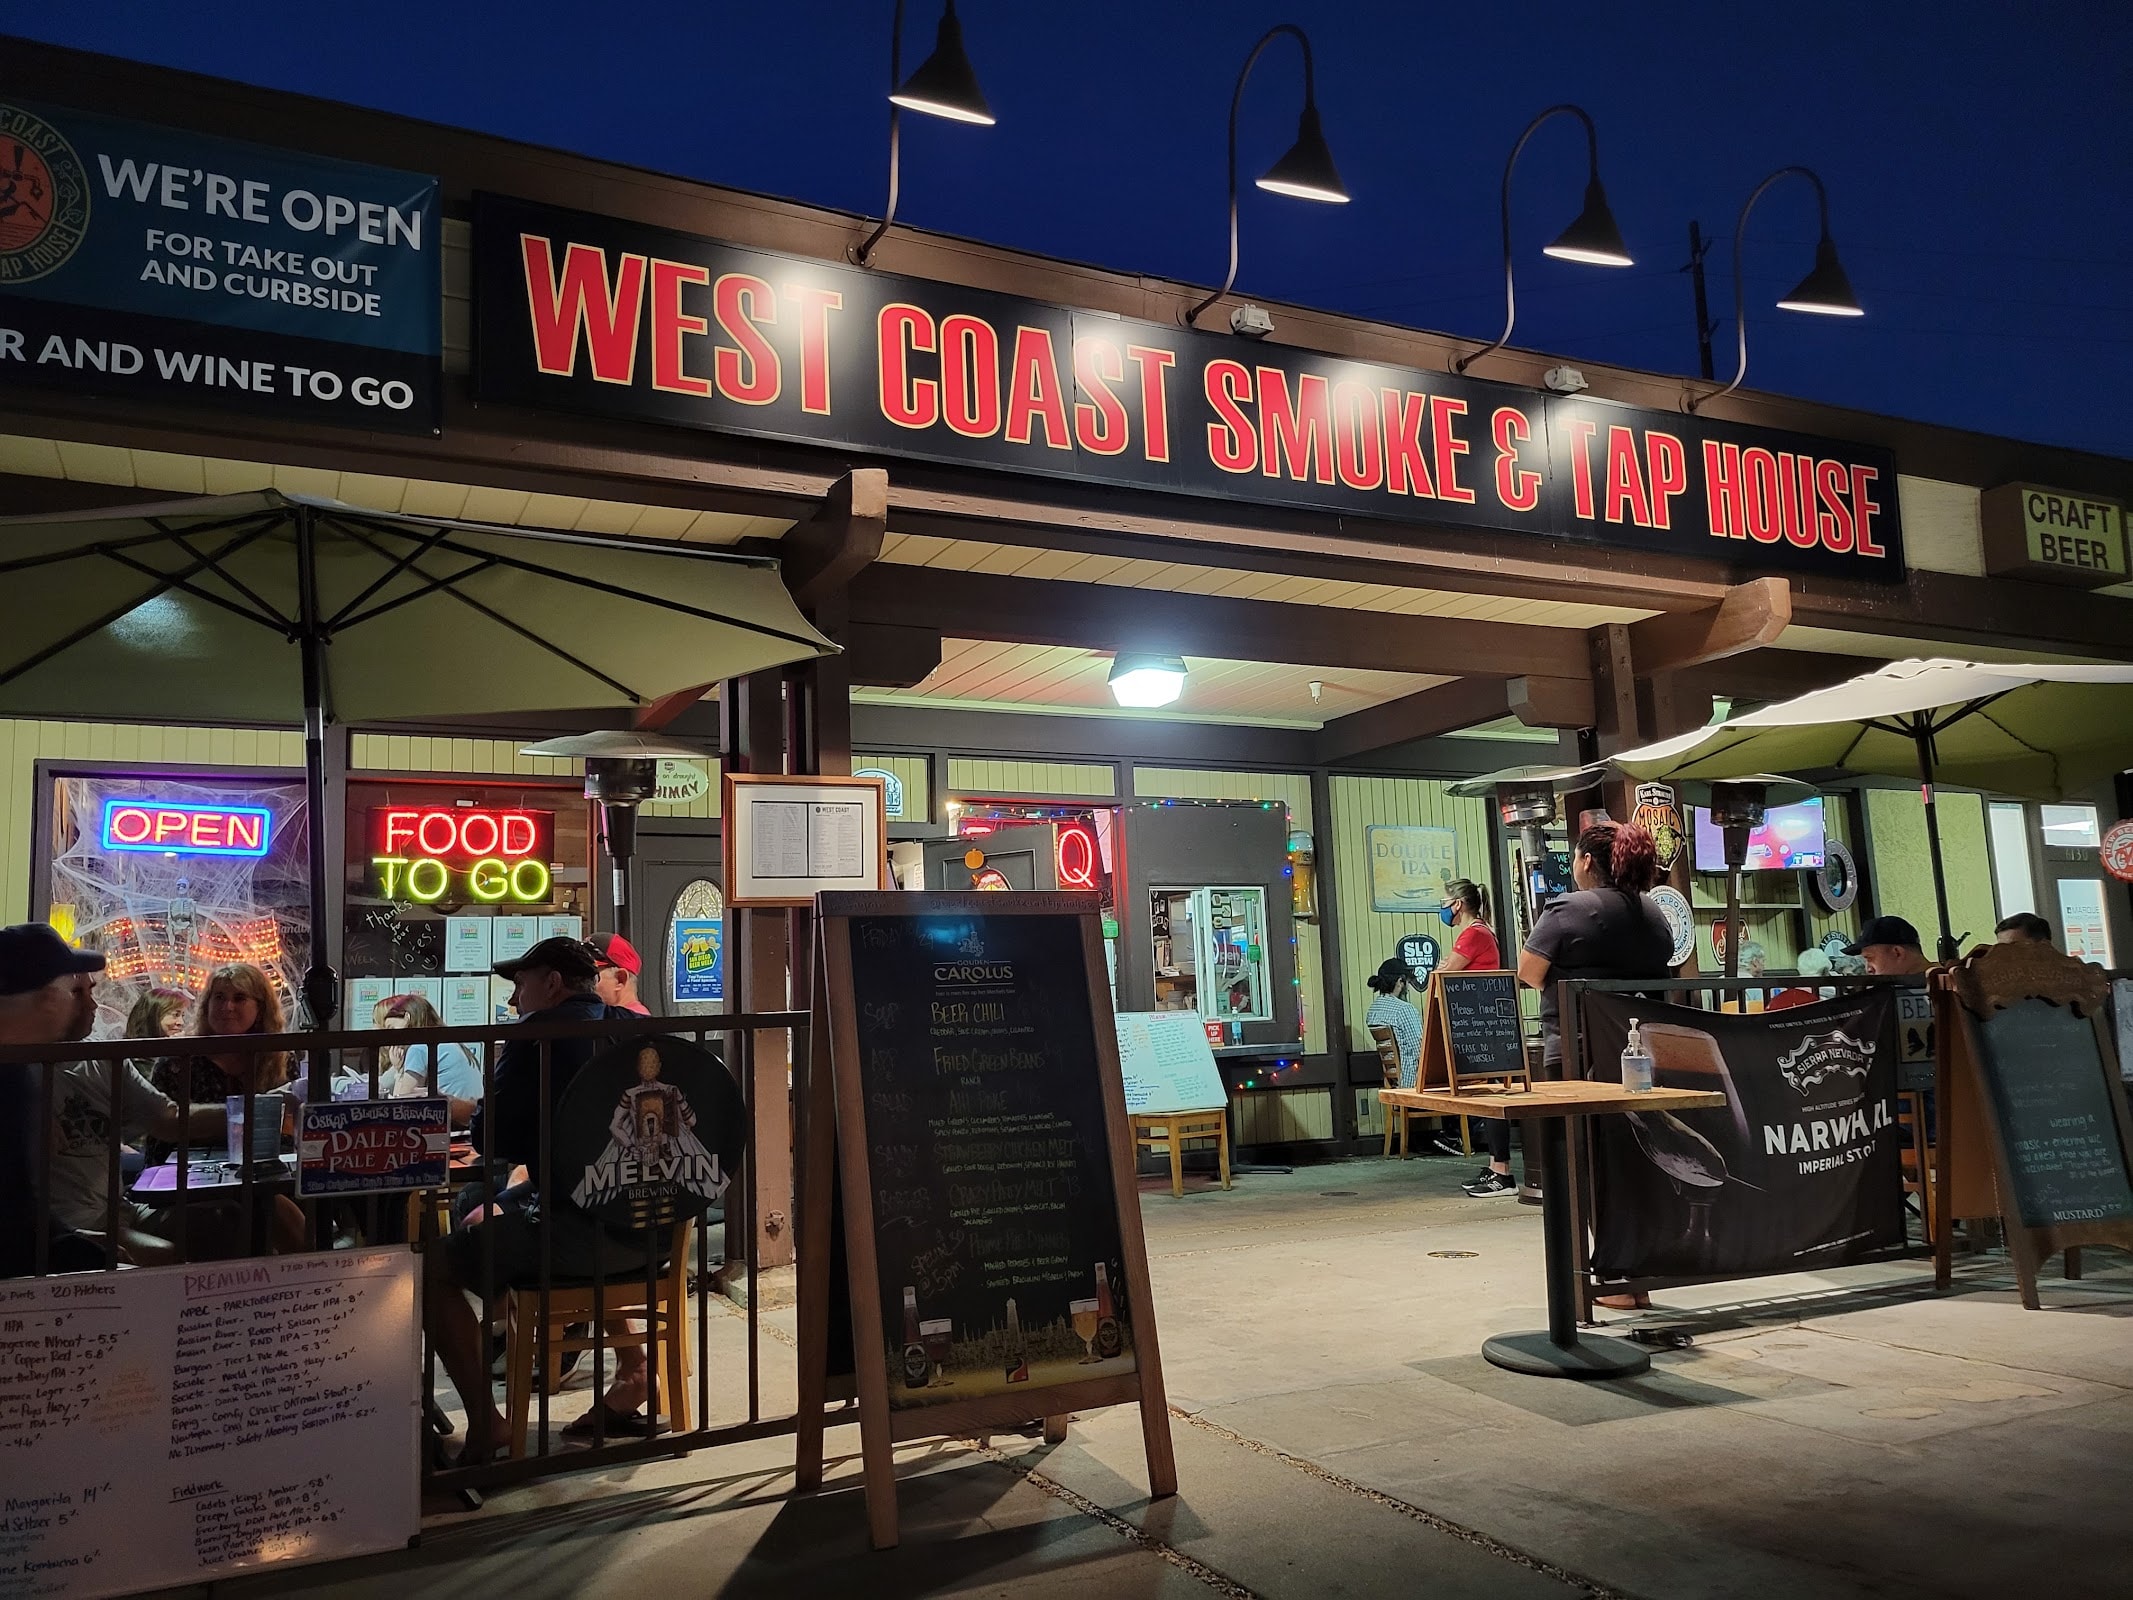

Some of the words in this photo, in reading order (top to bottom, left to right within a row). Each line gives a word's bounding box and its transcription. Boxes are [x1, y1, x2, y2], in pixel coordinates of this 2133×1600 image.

[98, 154, 270, 223] WE'RE
[281, 190, 421, 251] OPEN
[24, 227, 77, 272] HOUSE
[146, 229, 214, 261] FOR
[221, 241, 304, 276] TAKE
[311, 256, 378, 287] OUT
[140, 259, 216, 291] AND
[223, 273, 381, 317] CURBSIDE
[37, 335, 144, 375] AND
[154, 348, 275, 393] WINE
[284, 366, 343, 400] TO
[351, 377, 414, 409] GO
[520, 233, 843, 416] WEST
[878, 303, 1176, 463] COAST
[1204, 359, 1475, 505] SMOKE
[1491, 406, 1542, 512] &
[1557, 417, 1687, 531] TAP
[1702, 439, 1886, 558] HOUSE
[2029, 494, 2110, 533] CRAFT
[2040, 533, 2109, 569] BEER
[655, 780, 699, 799] HIMAY
[1639, 808, 1675, 826] MOSAIC
[110, 807, 264, 850] OPEN
[384, 811, 537, 856] FOOD
[1376, 841, 1452, 860] DOUBLE
[1401, 861, 1431, 875] IPA
[372, 856, 449, 900] TO
[469, 857, 550, 900] GO
[366, 899, 413, 929] thanks
[390, 920, 402, 937] for
[391, 924, 411, 945] your
[1404, 942, 1432, 957] SLO
[1405, 958, 1433, 966] BREW
[934, 965, 1014, 983] CAROLUS
[1462, 980, 1477, 992] Are
[930, 1001, 969, 1024] BEER
[973, 1002, 1005, 1023] CHILI
[1450, 1002, 1475, 1016] Please
[1479, 1002, 1496, 1015] have
[1472, 1017, 1485, 1027] from
[1487, 1019, 1498, 1028] your
[1500, 1018, 1517, 1028] party
[1485, 1028, 1493, 1037] for
[1454, 1043, 1476, 1054] PLEASE
[1506, 1043, 1519, 1051] SEAT
[933, 1046, 969, 1076] FRIED
[1466, 1054, 1495, 1063] YOURSELF
[1796, 1050, 1829, 1075] SIERRA
[1828, 1048, 1865, 1064] NEVADA
[307, 1112, 349, 1130] OSKAR
[351, 1105, 390, 1122] BLUES
[392, 1104, 446, 1124] BREWERY
[1801, 1105, 1815, 1113] HIGH
[1815, 1102, 1838, 1111] ALTITUDE
[2050, 1115, 2087, 1131] wearing
[330, 1126, 422, 1154] DALE'S
[329, 1153, 376, 1174] PALE
[383, 1151, 421, 1170] ALE
[1799, 1154, 1845, 1175] IMPERIAL
[584, 1153, 720, 1196] MELVIN
[628, 1184, 678, 1200] BREWING
[2053, 1208, 2105, 1222] MUSTARD
[74, 1284, 116, 1297] Pitchers
[183, 1267, 271, 1296] PREMIUM
[223, 1290, 302, 1312] PARKTOBERFEST
[248, 1323, 283, 1337] Robert
[15, 1352, 46, 1370] Copper
[261, 1362, 298, 1375] Wonders
[212, 1408, 243, 1422] Comfy
[324, 1386, 349, 1399] Stout
[303, 1405, 326, 1416] Cider
[332, 1412, 347, 1423] IPA
[5, 1492, 71, 1514] Margarita
[13, 1515, 51, 1532] Seltzer
[23, 1557, 79, 1574] Kombucha
